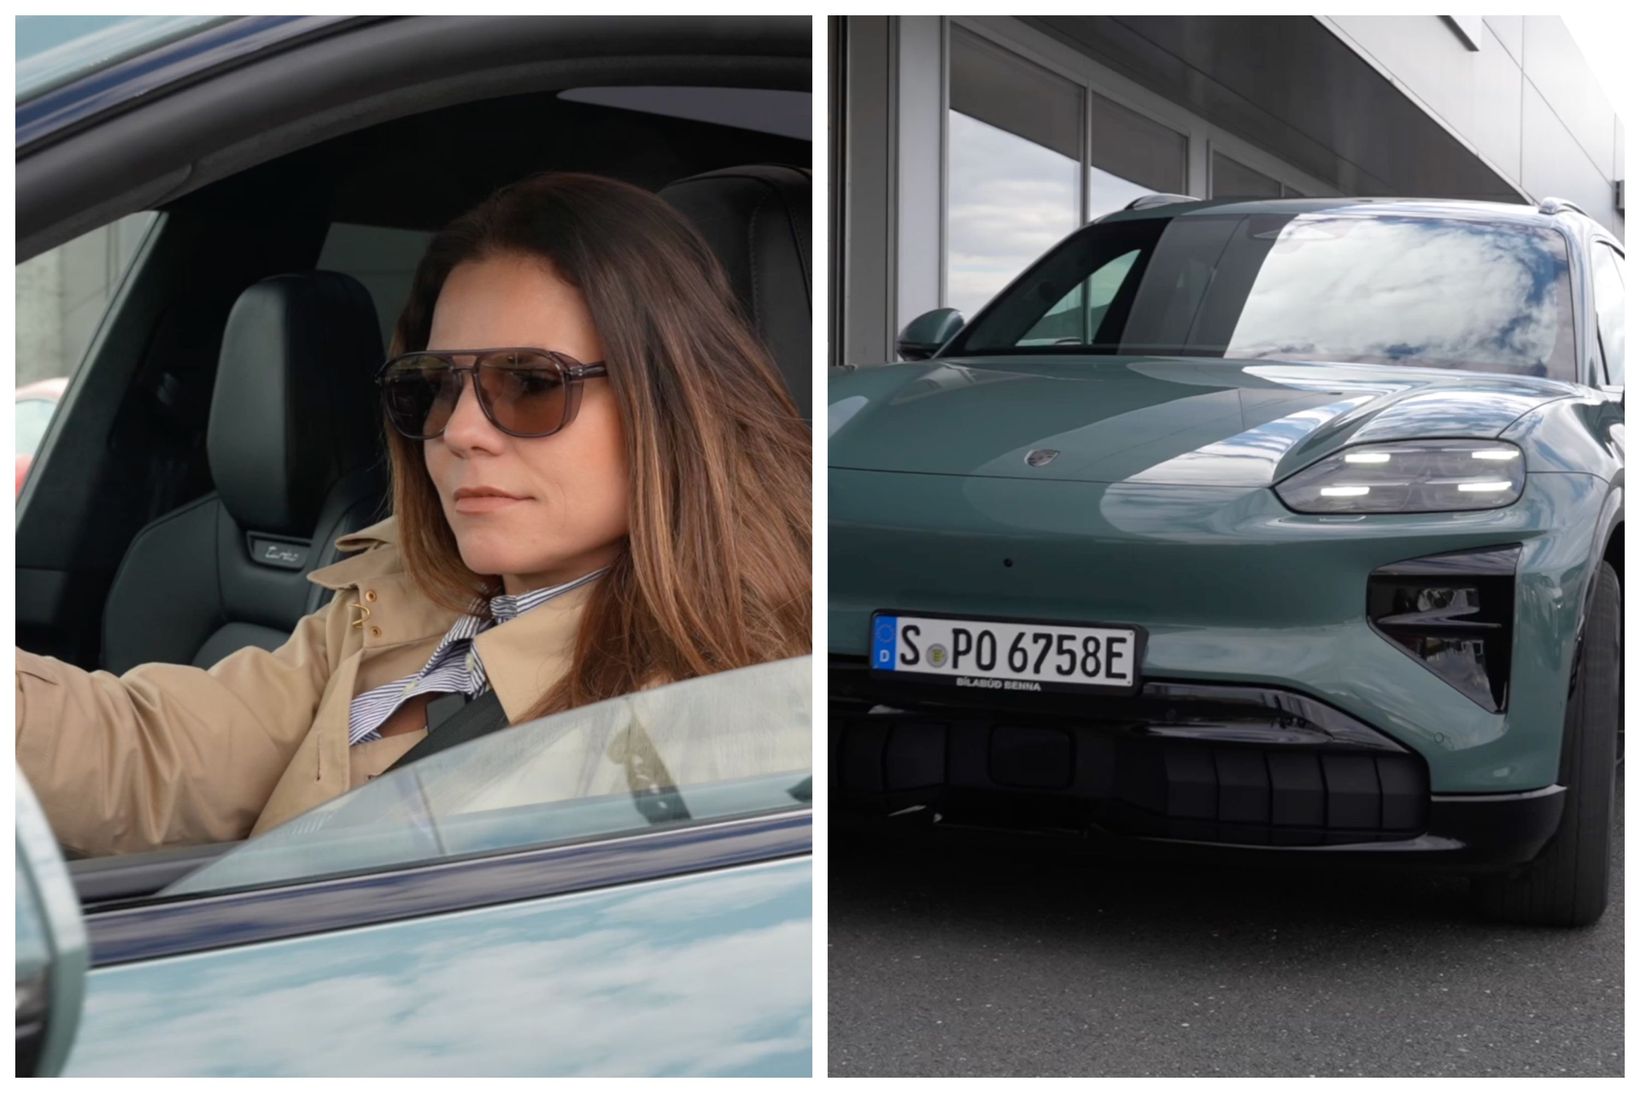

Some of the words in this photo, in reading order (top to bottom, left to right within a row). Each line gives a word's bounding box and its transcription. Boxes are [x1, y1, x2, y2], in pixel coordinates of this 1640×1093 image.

[879, 649, 890, 663] D
[900, 625, 921, 666] S
[1008, 631, 1128, 680] 6758E
[1004, 679, 1041, 691] BENNA
